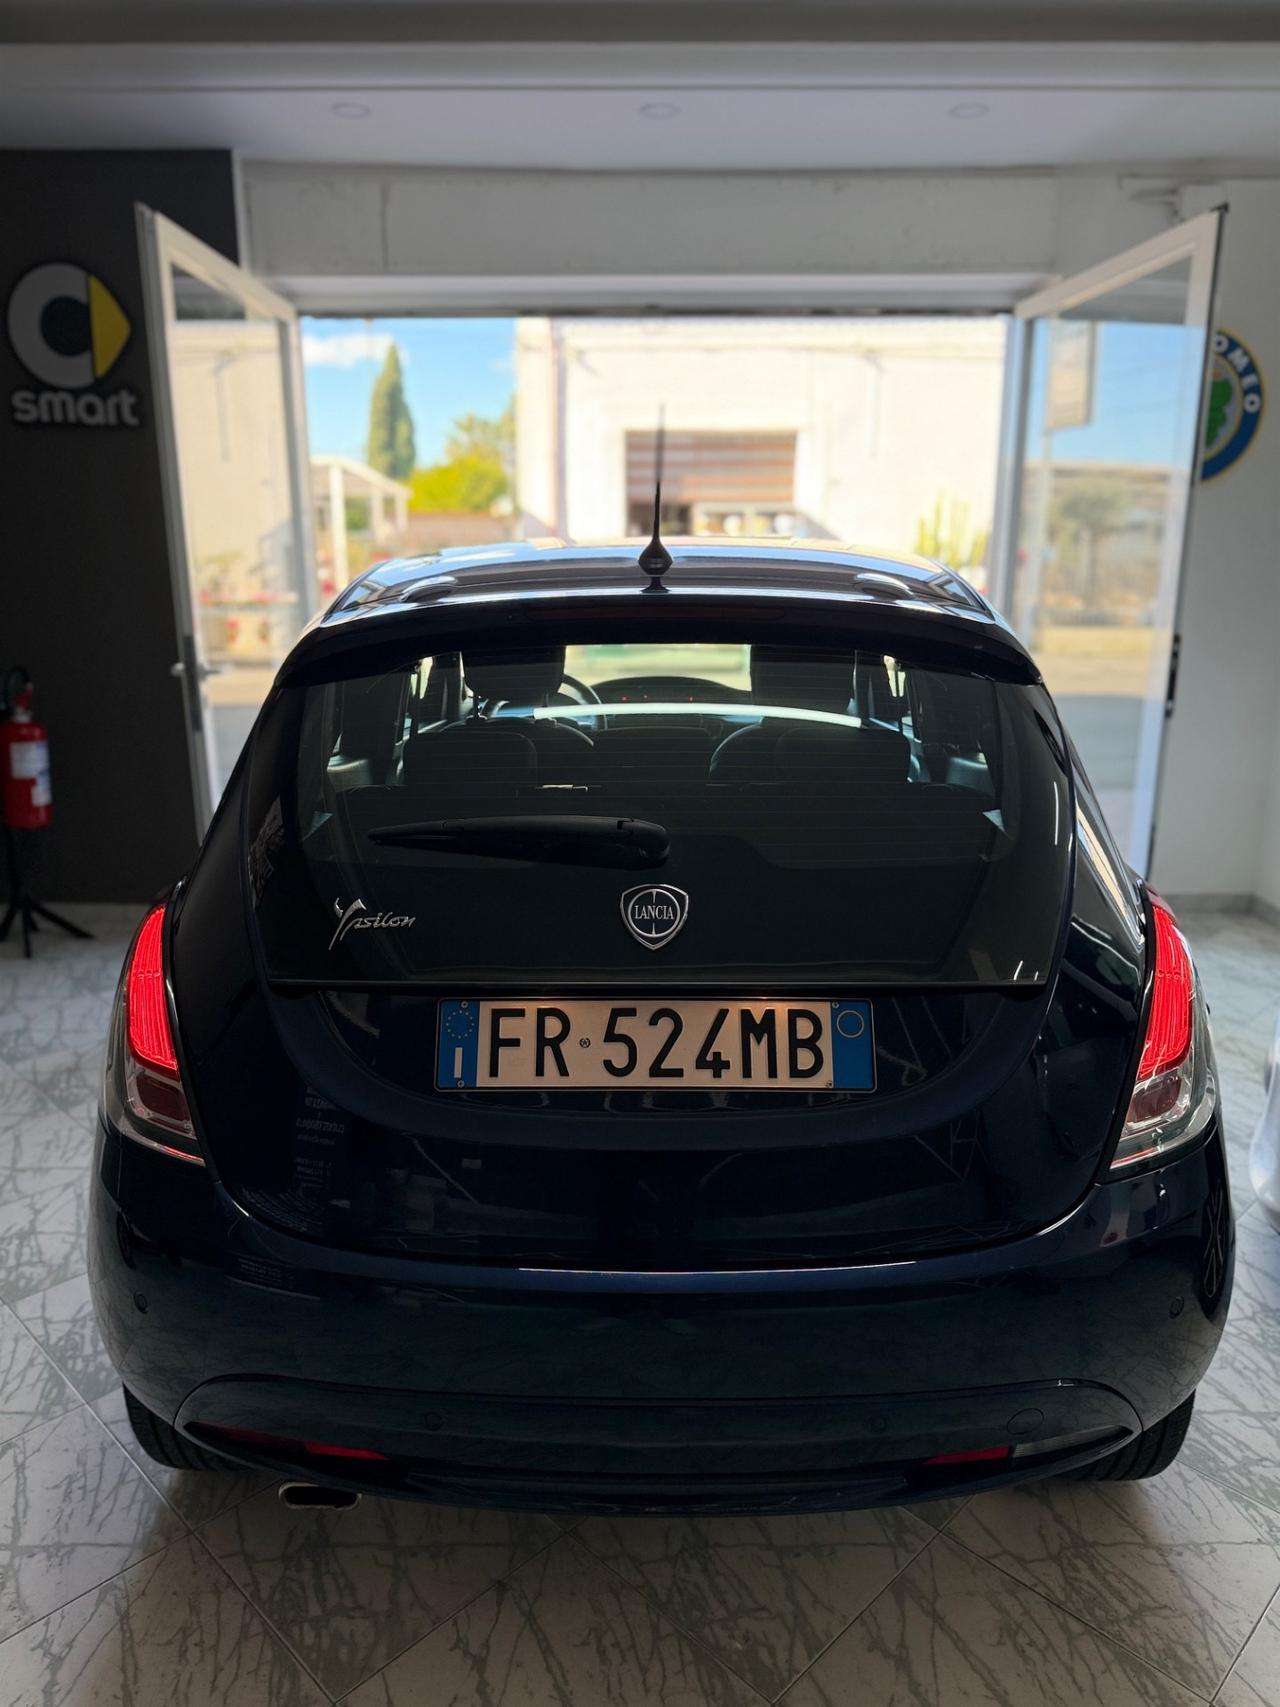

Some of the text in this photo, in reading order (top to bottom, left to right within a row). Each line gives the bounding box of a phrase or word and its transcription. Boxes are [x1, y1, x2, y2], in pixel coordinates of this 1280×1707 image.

[1212, 333, 1262, 413] OMEO
[11, 389, 139, 426] smart
[328, 897, 416, 950] Ypsilon
[634, 904, 675, 920] LANCIA
[489, 1007, 825, 1079] FR 524MB
